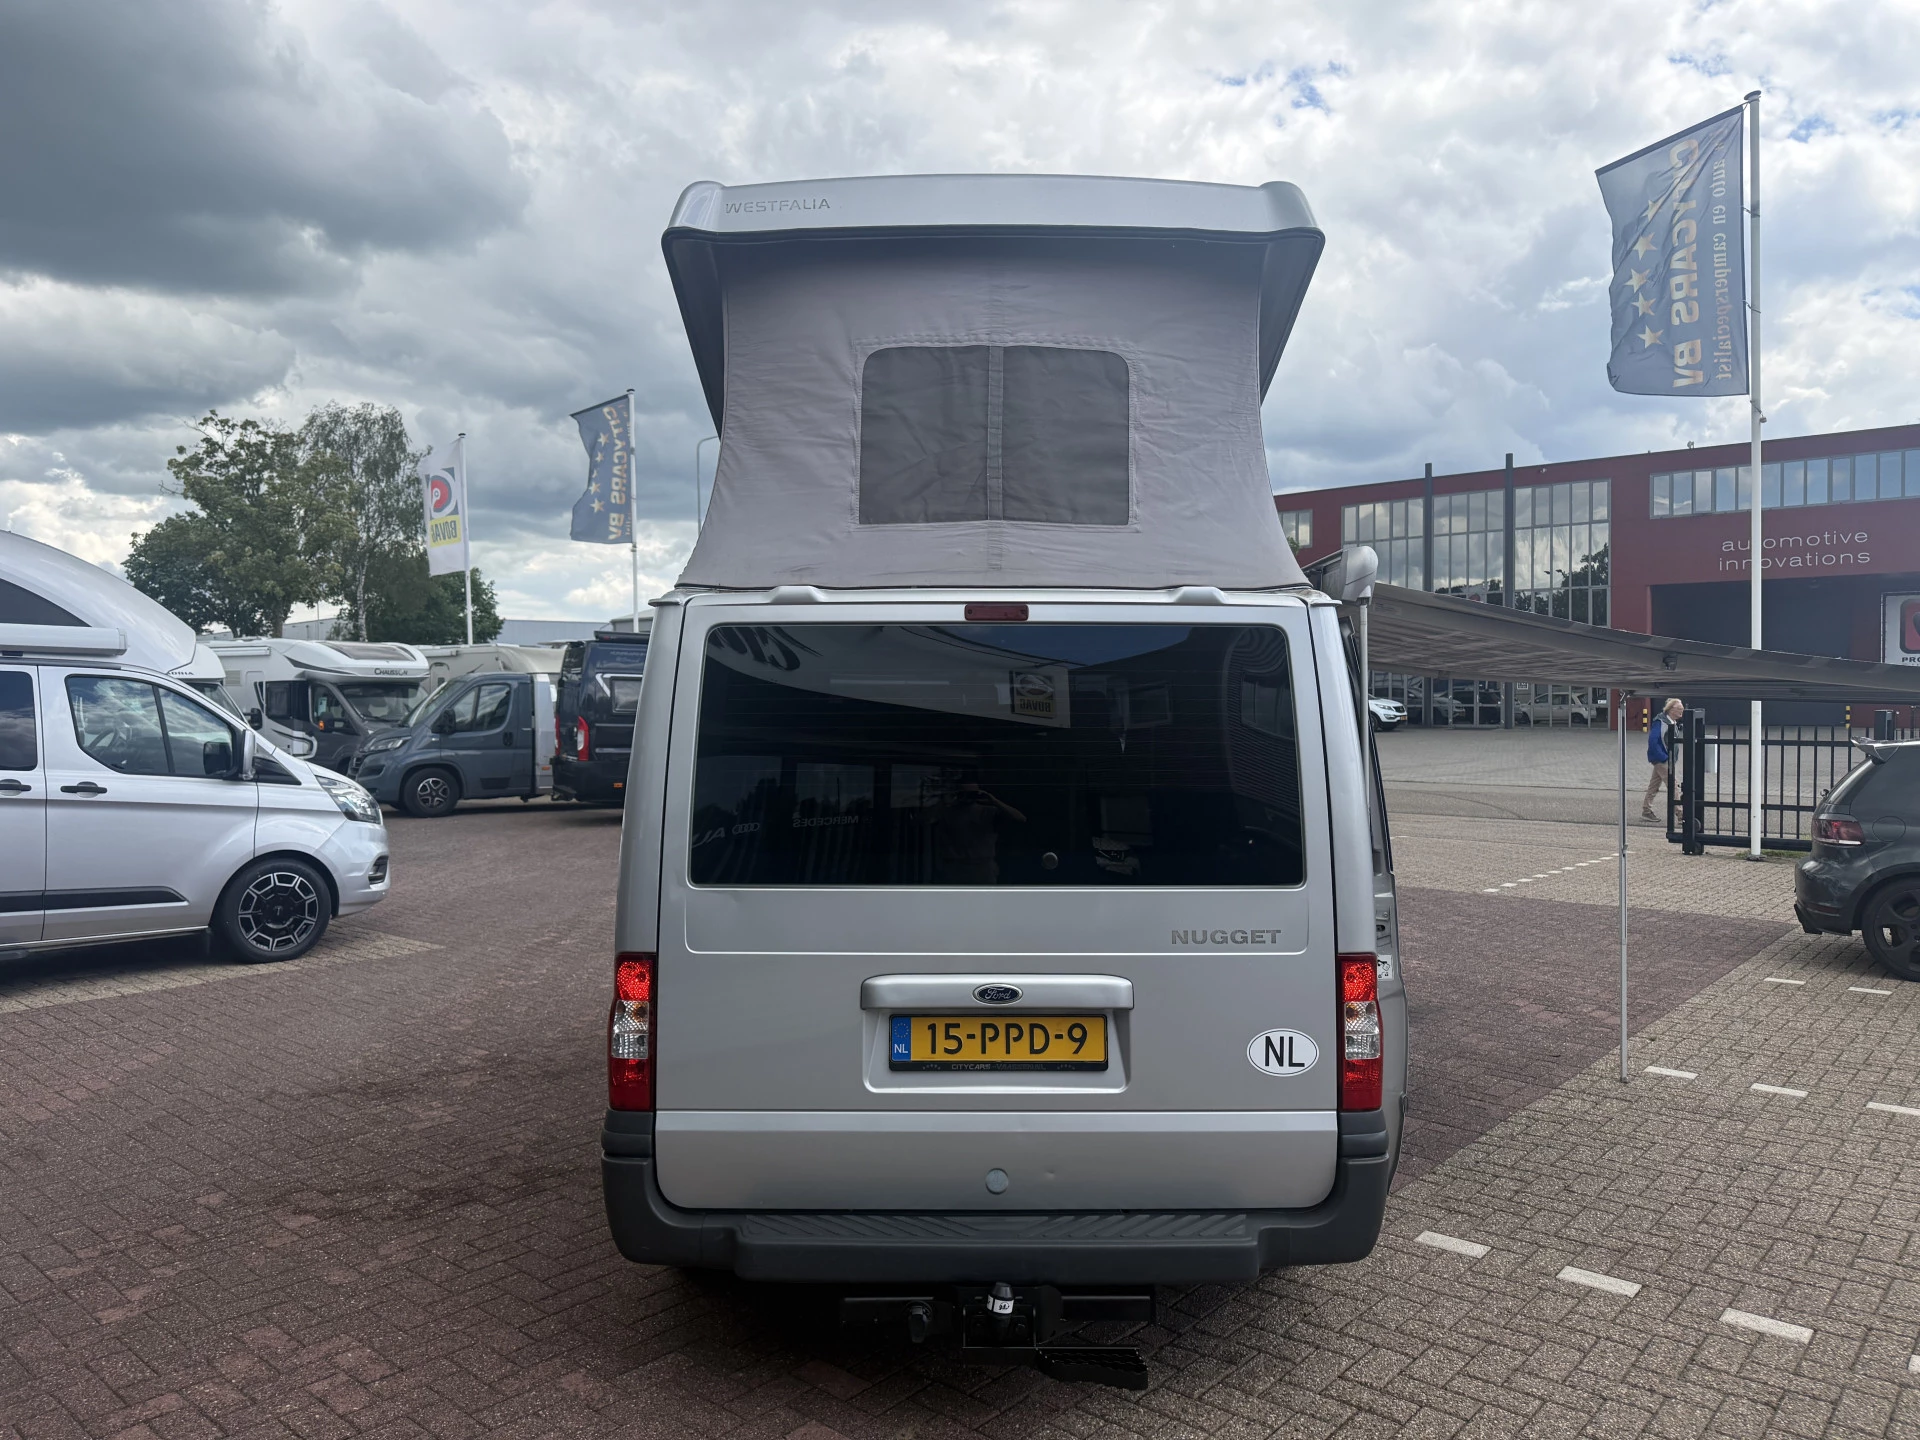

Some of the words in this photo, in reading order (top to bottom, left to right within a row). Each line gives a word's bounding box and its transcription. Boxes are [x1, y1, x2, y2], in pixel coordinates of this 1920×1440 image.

[725, 198, 831, 214] WESTFALIA
[1722, 530, 1868, 552] auomotive
[1171, 929, 1282, 945] NUGGET
[984, 986, 1012, 1000] Ford
[927, 1022, 1088, 1055] 15-PPD-9
[893, 1043, 909, 1054] NL
[1264, 1035, 1305, 1068] NL
